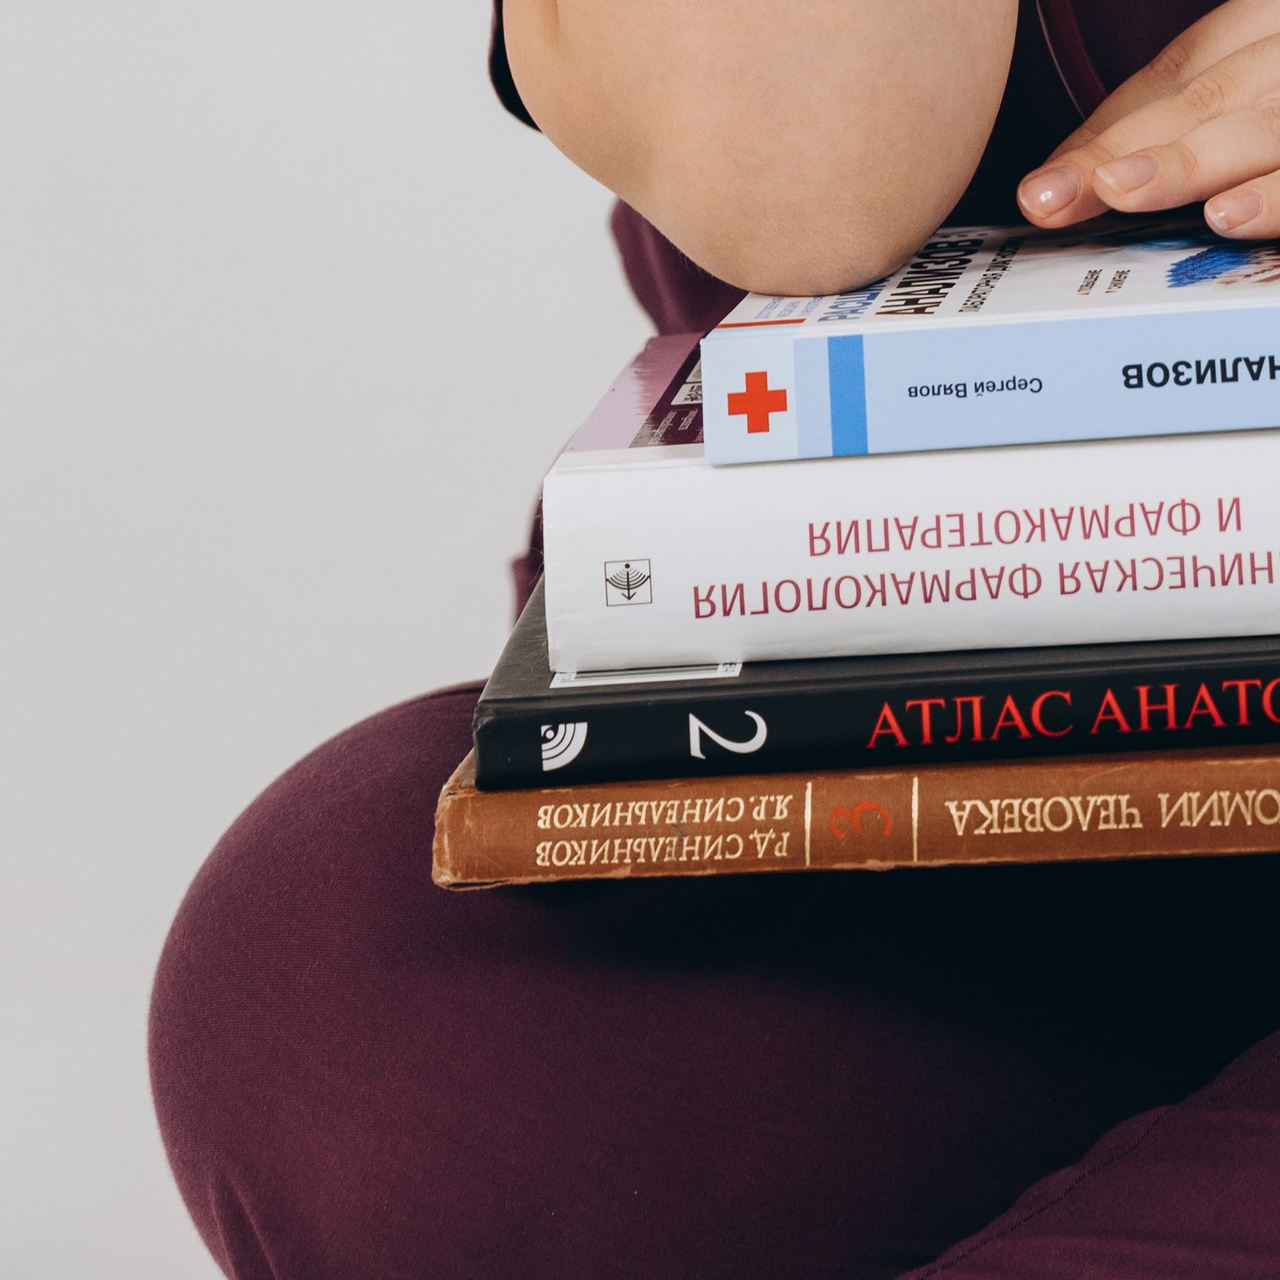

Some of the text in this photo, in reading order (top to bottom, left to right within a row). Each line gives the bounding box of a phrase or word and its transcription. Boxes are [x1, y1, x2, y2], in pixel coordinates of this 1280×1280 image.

[875, 239, 984, 315] АНАЛИЗОВ
[907, 376, 1042, 399] Сергей Вялов
[809, 497, 1241, 556] И ФАРМАКОТЕРАПИЯ
[694, 563, 1041, 619] ФАРМАКОЛОГИЯ
[689, 711, 767, 758] 2
[869, 691, 1070, 747] АТЛАС
[537, 797, 744, 829] СИНЕЛЬНИКОВ
[828, 799, 892, 839] 3
[945, 795, 1142, 835] ЧЕЛОВЕКА
[536, 834, 743, 866] СИНЕЛЬНИКОВ
